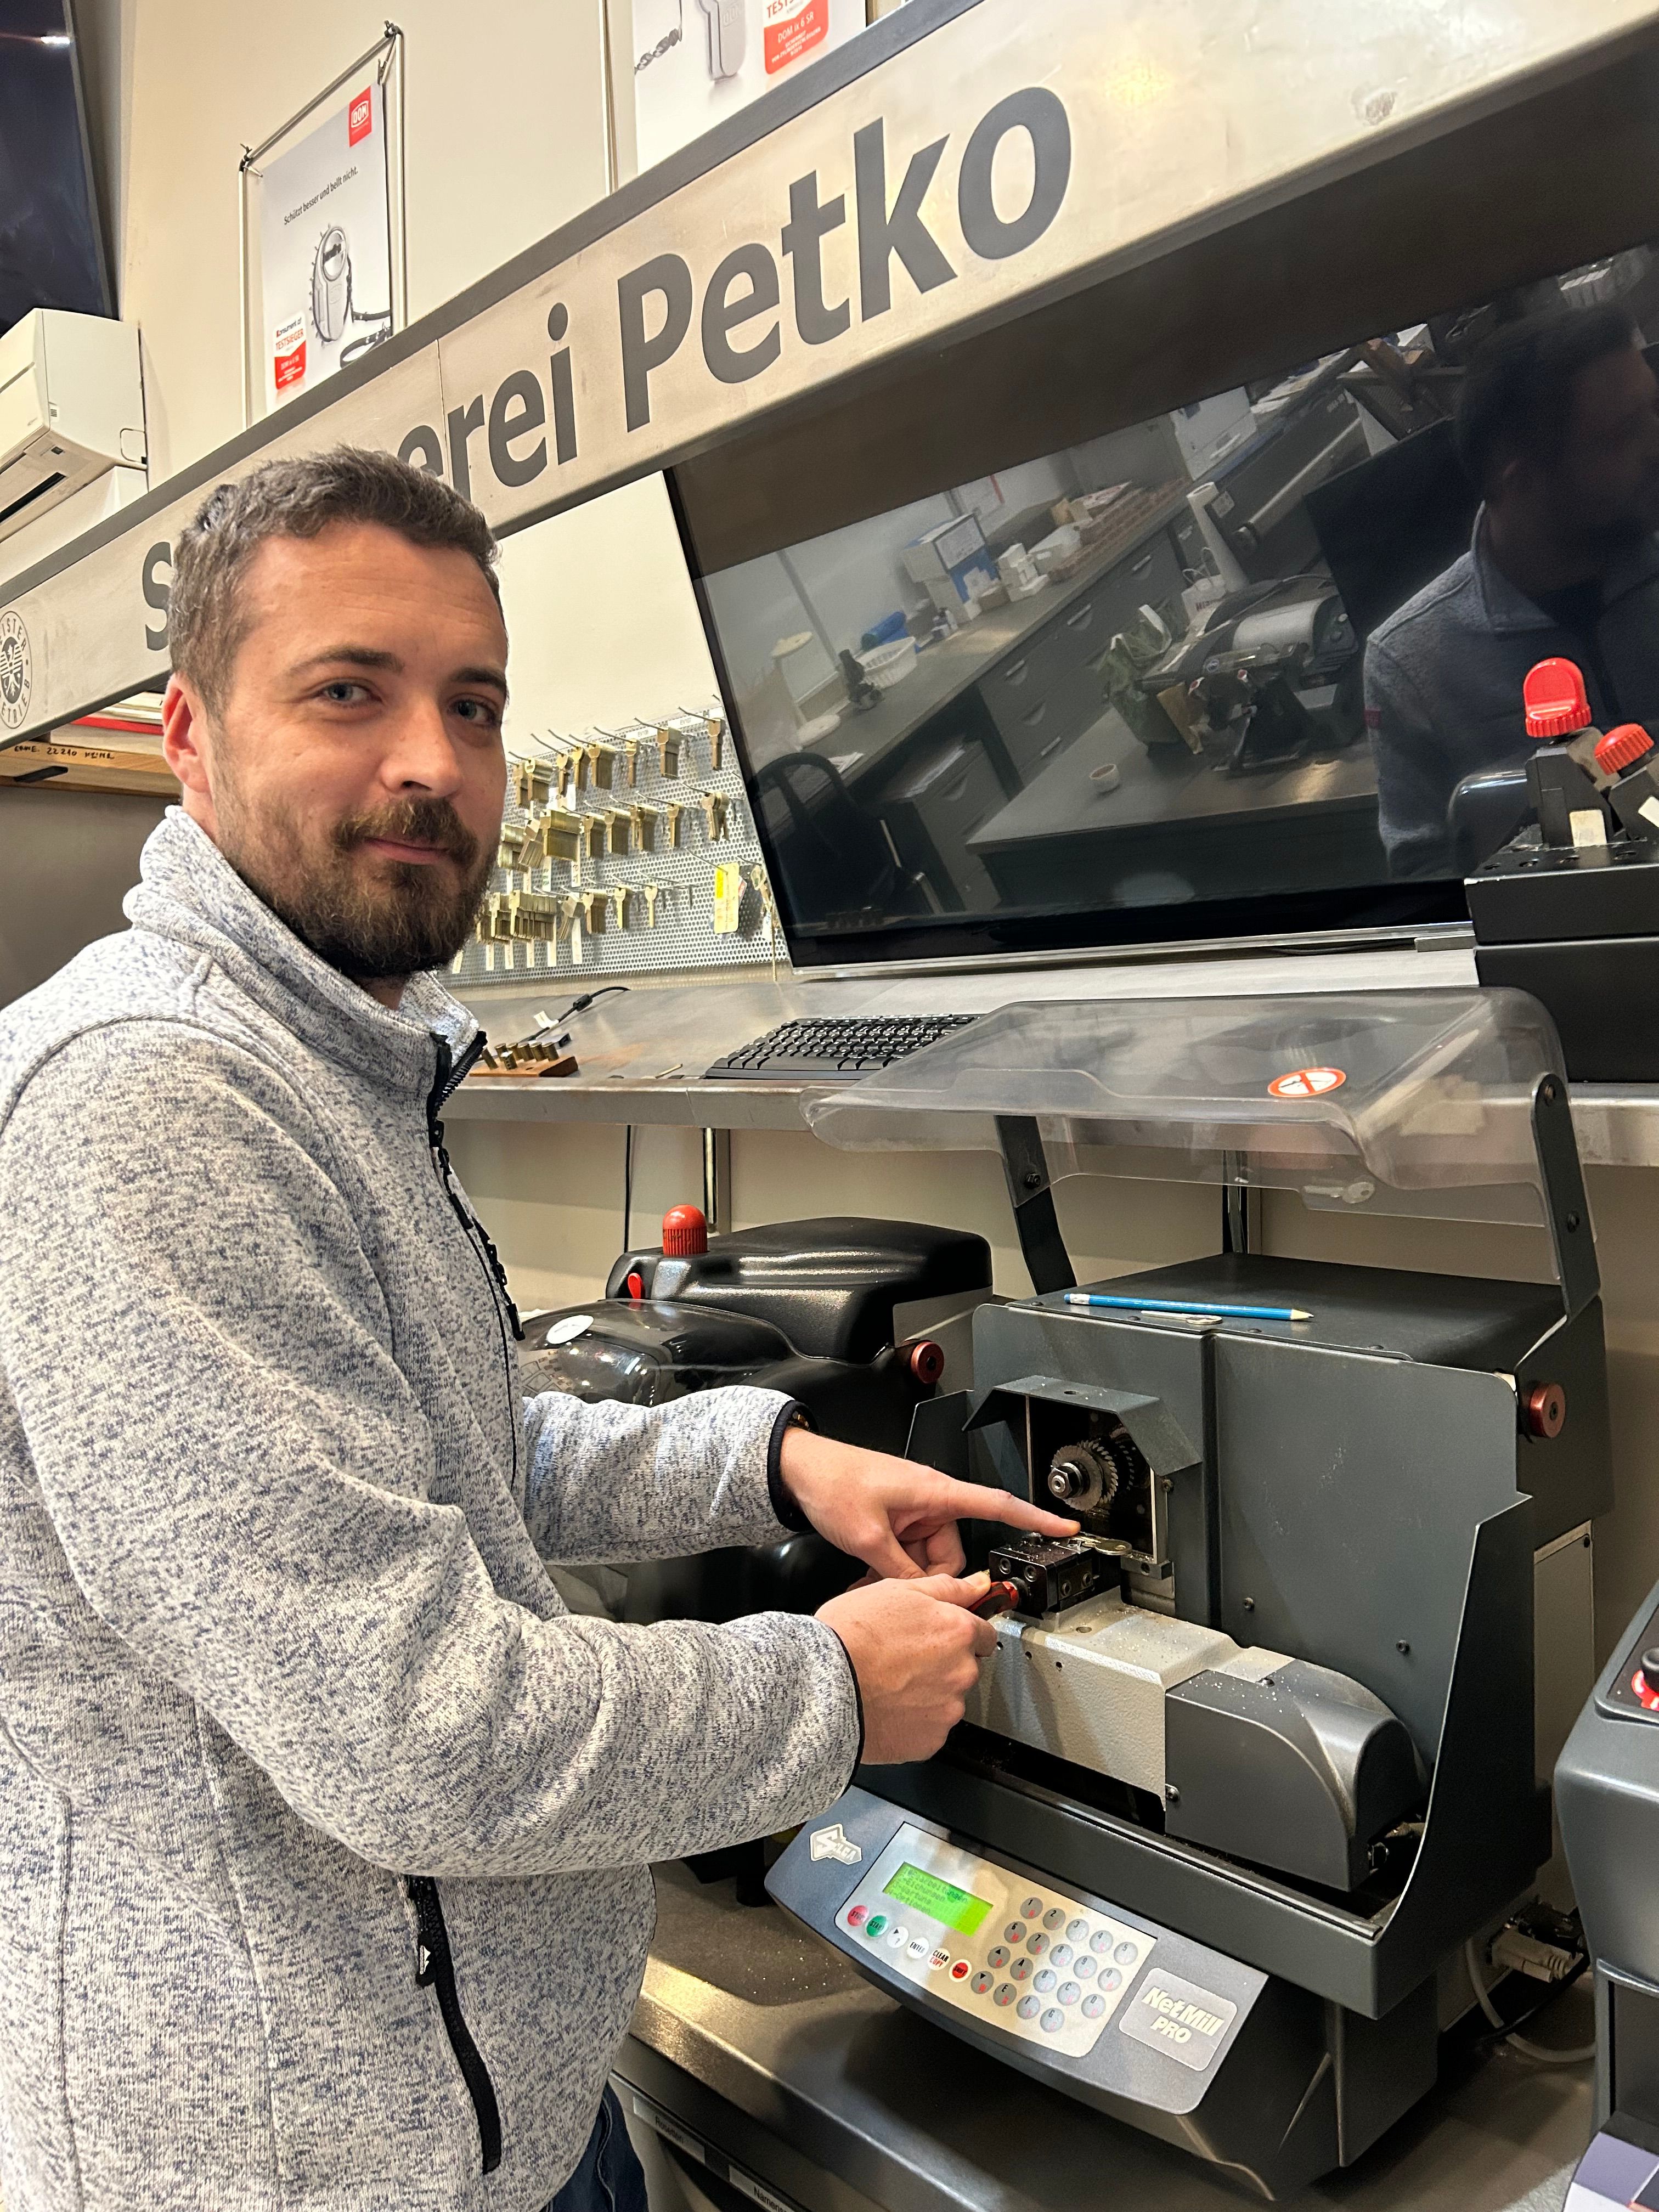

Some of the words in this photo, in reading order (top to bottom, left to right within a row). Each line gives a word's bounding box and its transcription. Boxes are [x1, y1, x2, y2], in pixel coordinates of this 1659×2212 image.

[778, 25, 793, 43] DOM
[800, 18, 805, 27] 6
[806, 12, 814, 24] SR
[353, 104, 366, 125] DOM
[284, 206, 302, 225] Schützt
[303, 194, 319, 212] besser
[320, 184, 329, 200] und
[330, 177, 342, 191] bellt
[343, 166, 358, 183] nicht.
[618, 87, 1071, 433] Petko
[275, 328, 303, 351] TESTSIEGER
[910, 1942, 926, 1954] ENTER
[929, 1956, 944, 1968] COPY
[933, 1950, 949, 1963] CLEAR
[1018, 1959, 1025, 1967] A
[1042, 1971, 1049, 1979] B
[1065, 1983, 1072, 1991] C
[1091, 1996, 1097, 2004] D
[1048, 2010, 1056, 2018] G
[1141, 1987, 1225, 2036] NetMill
[1150, 2015, 1192, 2044] PRO
